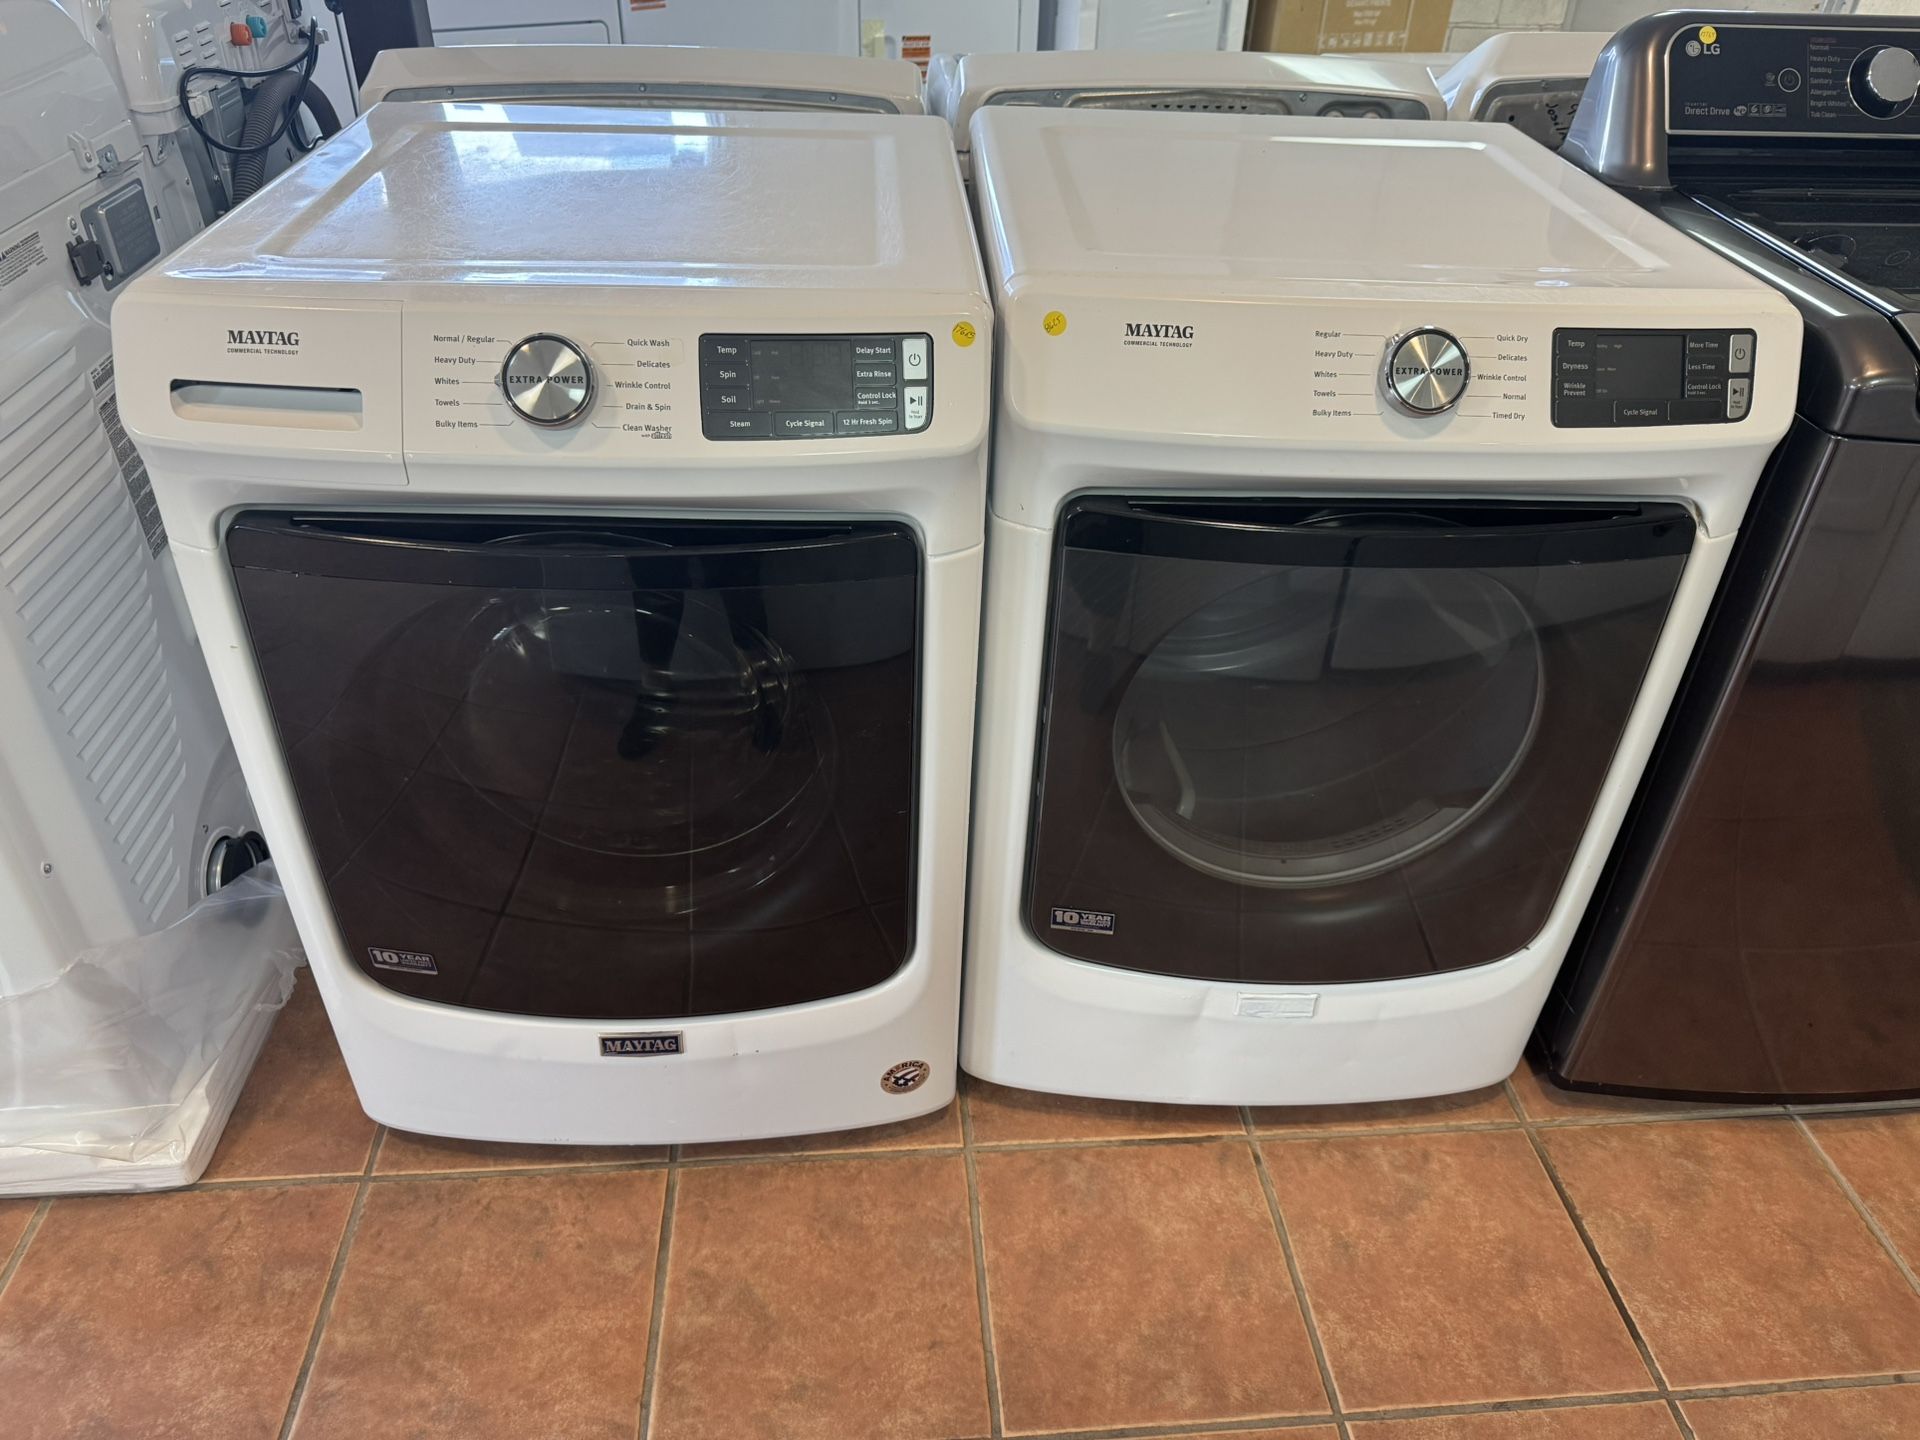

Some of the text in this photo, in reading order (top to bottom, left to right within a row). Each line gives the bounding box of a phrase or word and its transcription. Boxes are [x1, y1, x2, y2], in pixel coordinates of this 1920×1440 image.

[1704, 44, 1720, 54] LG
[1685, 107, 1729, 115] Direct Drive
[1125, 323, 1194, 339] MAYTAG
[227, 330, 300, 346] MAYTAG
[433, 335, 460, 343] Normal
[467, 335, 495, 344] Regular
[627, 338, 670, 347] Quick Wash
[1568, 340, 1585, 348] Temp
[717, 346, 737, 355] Temp
[1337, 351, 1353, 359] Duty
[434, 356, 476, 364] Heavy Duty
[720, 371, 736, 379] Spin
[1430, 368, 1463, 376] POWER
[546, 376, 584, 384] POWER
[654, 403, 671, 411] Spin
[435, 420, 478, 429] Bulky Items
[803, 420, 825, 428] Signal
[1055, 911, 1079, 923] 10
[1081, 913, 1112, 921] YEAR
[373, 951, 399, 963] 10
[605, 1039, 676, 1051] MAYTAG
